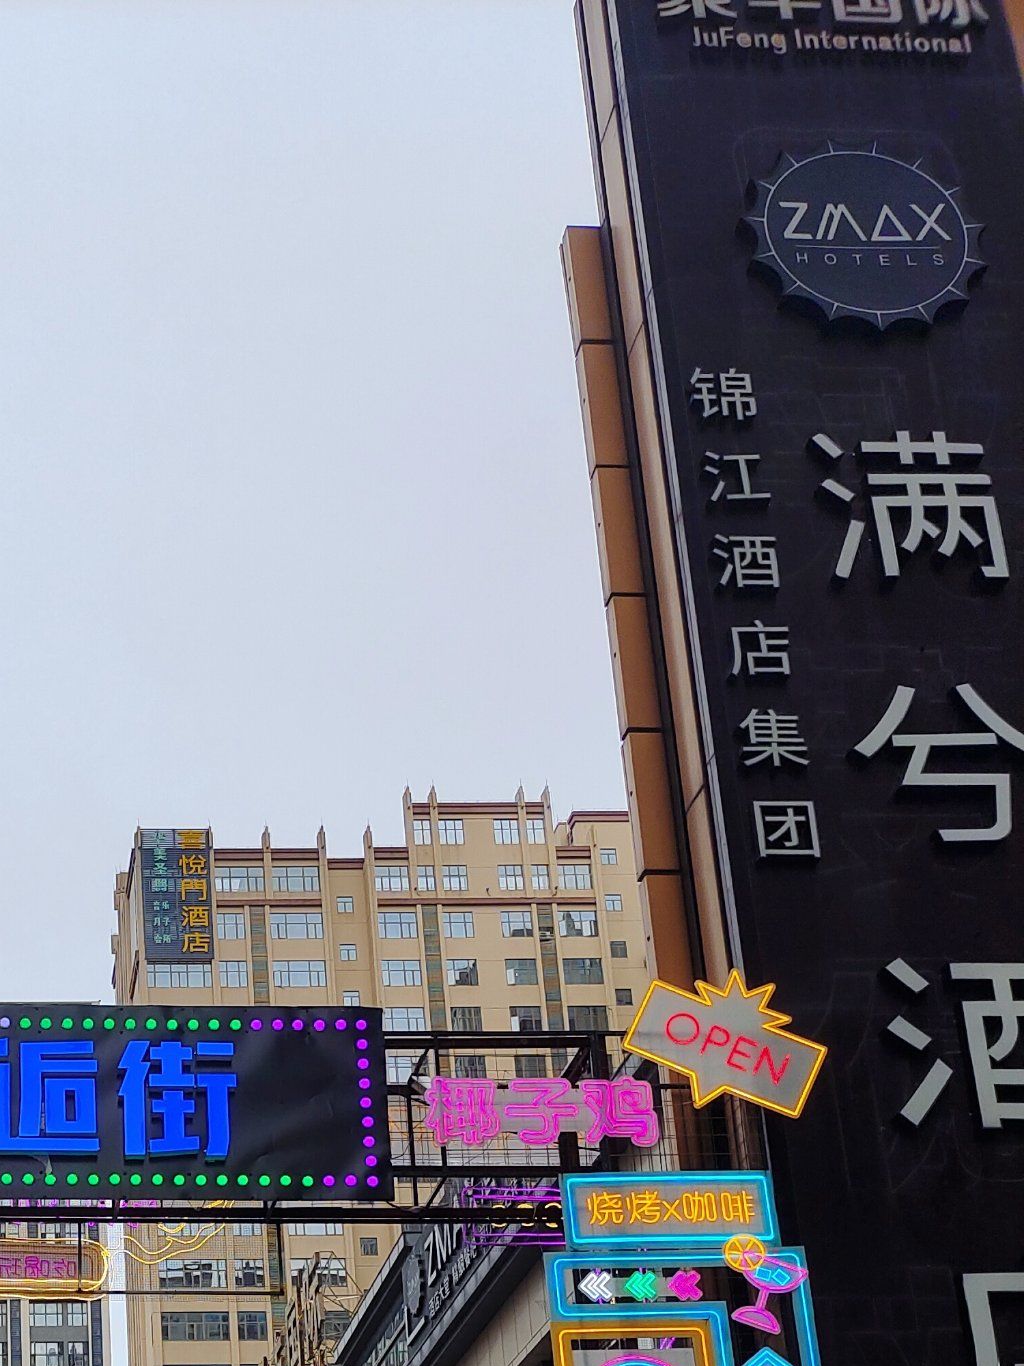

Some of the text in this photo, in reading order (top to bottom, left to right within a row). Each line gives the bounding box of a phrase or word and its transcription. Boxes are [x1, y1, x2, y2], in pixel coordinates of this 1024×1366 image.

[693, 26, 972, 54] JuFeng International
[779, 201, 952, 242] ZMAX
[796, 252, 944, 267] HOTELS
[689, 368, 821, 858] 锦江酒店集团
[665, 1012, 790, 1086] OPEN
[424, 1075, 659, 1147] 椰子鸡
